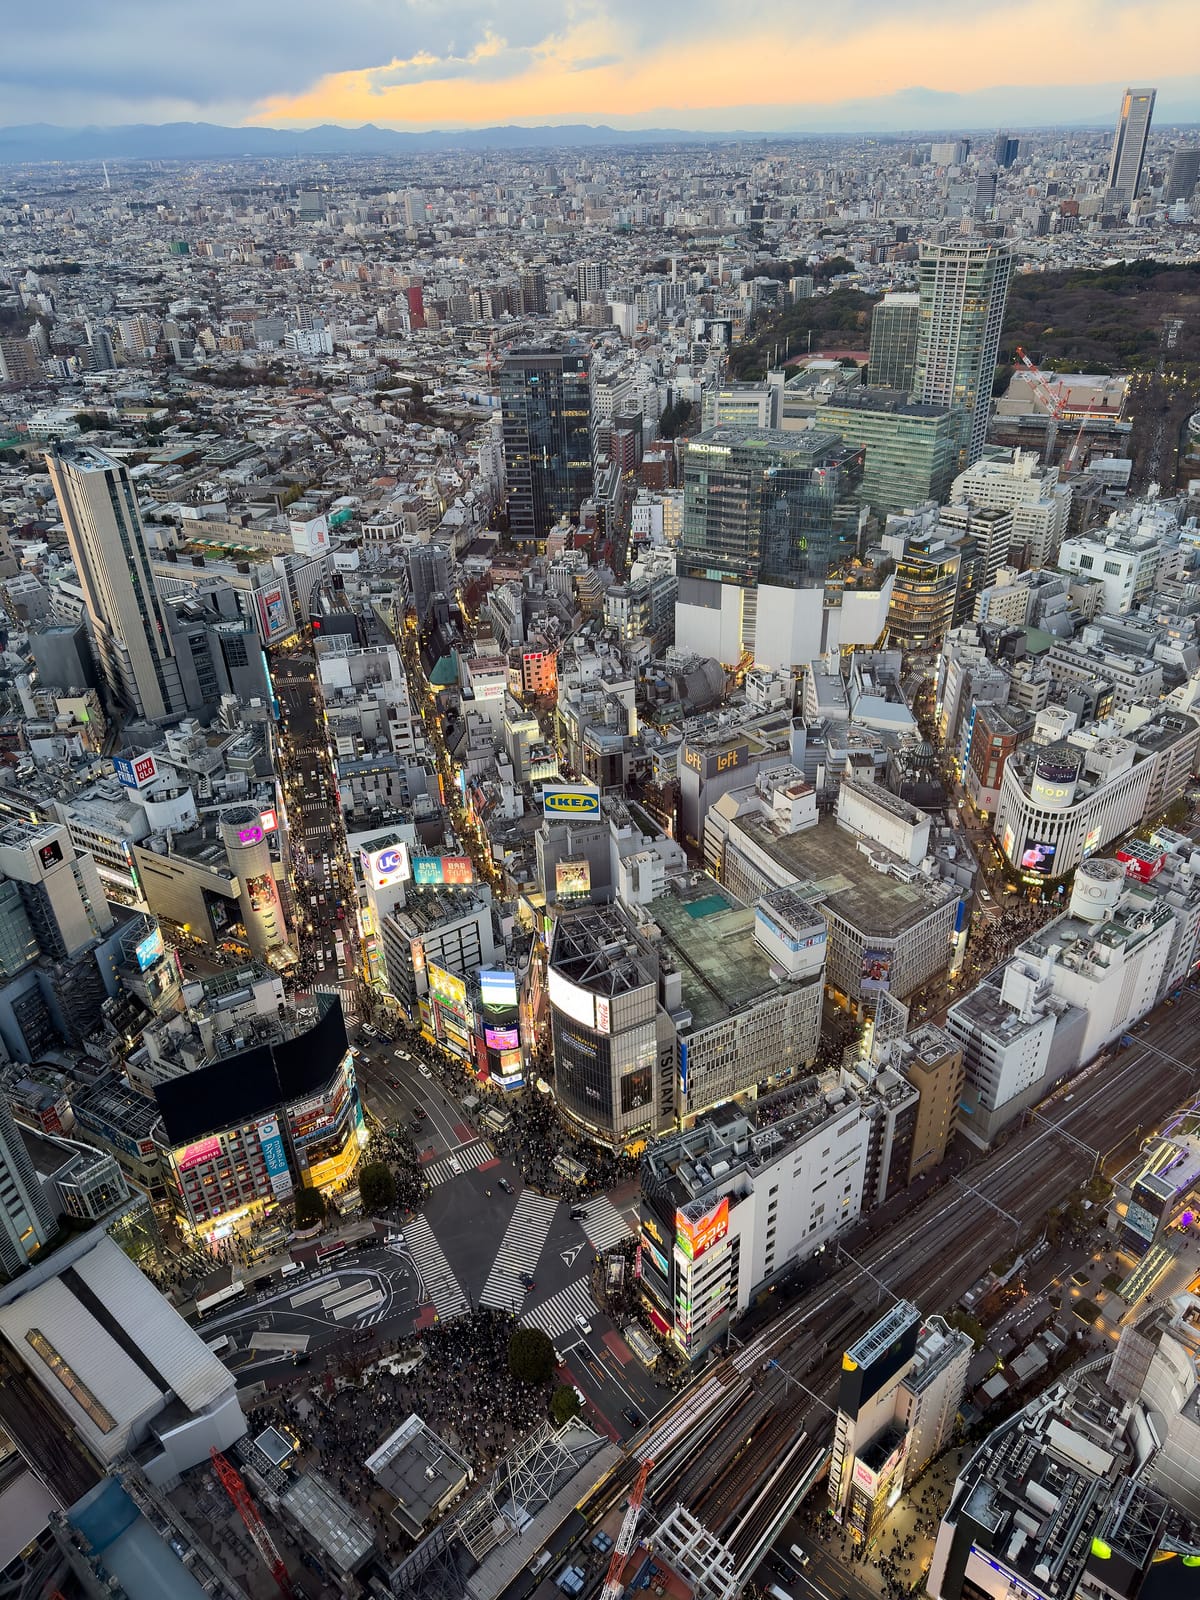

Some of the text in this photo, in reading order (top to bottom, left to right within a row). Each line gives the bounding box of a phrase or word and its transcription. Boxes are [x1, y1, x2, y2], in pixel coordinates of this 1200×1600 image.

[136, 760, 150, 772] UNI
[139, 767, 153, 779] QLO
[1035, 784, 1069, 798] MODI
[550, 797, 594, 808] IKEA
[379, 854, 400, 870] UC
[660, 1045, 674, 1117] TSUTAYA
[696, 1221, 726, 1250] アコム
